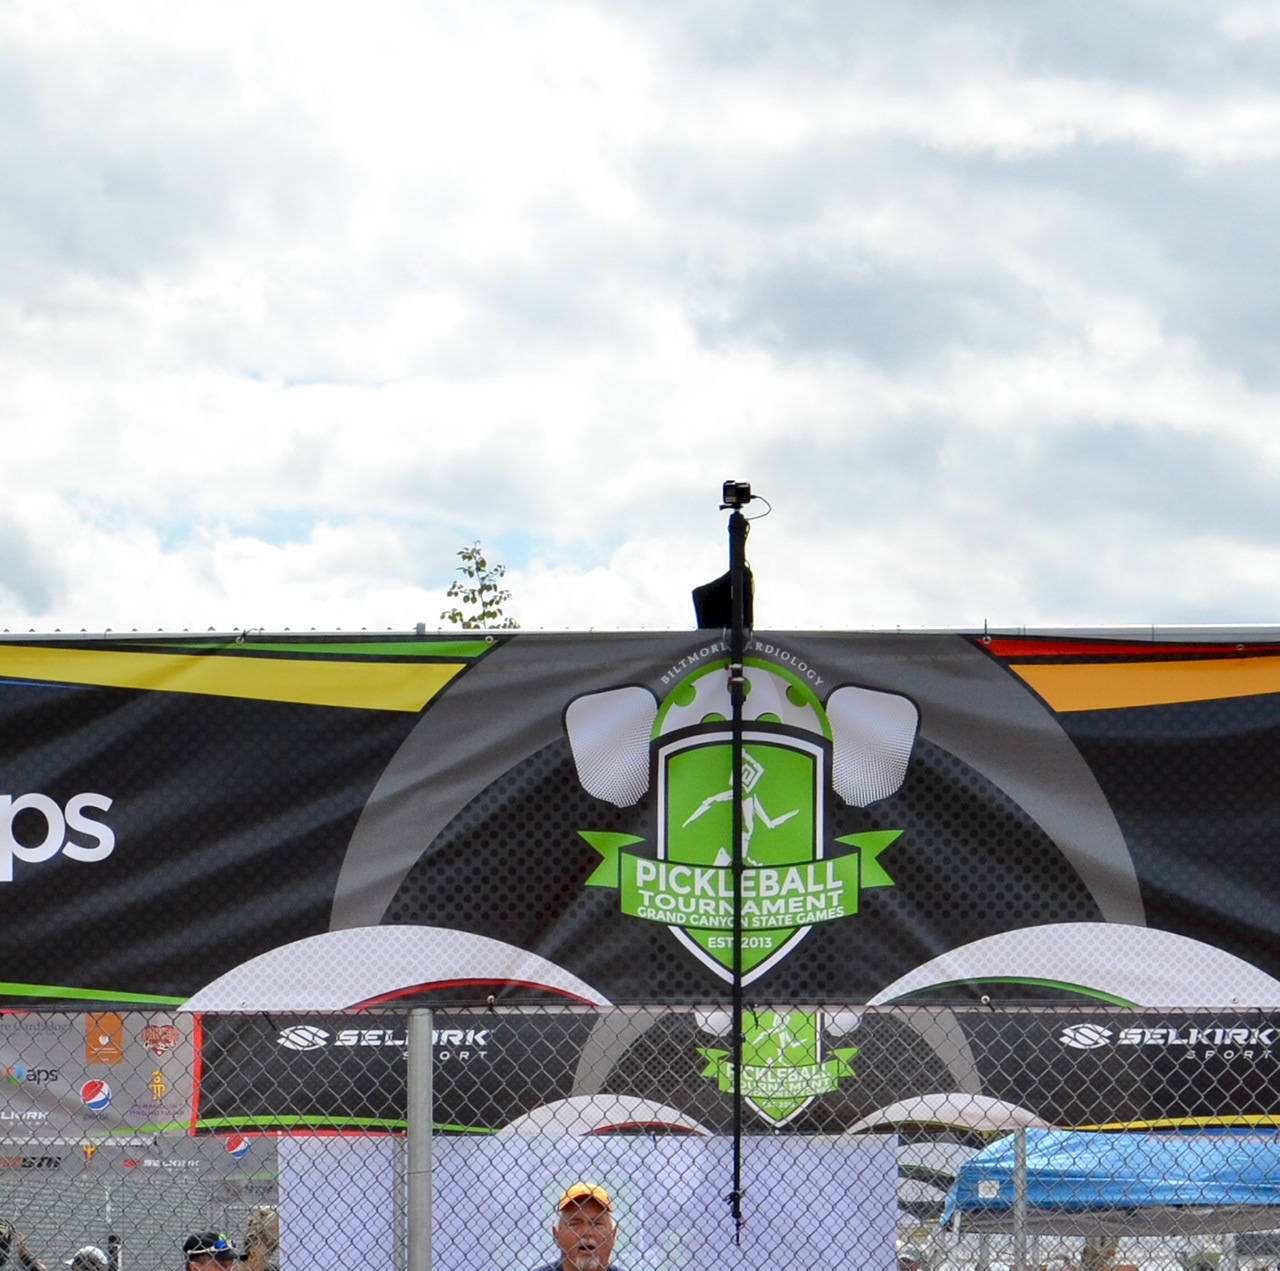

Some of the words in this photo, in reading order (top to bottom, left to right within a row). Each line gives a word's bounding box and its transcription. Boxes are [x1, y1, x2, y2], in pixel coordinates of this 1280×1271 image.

[636, 859, 844, 898] PICKLEBALL
[638, 890, 844, 916] TOURNAMENT
[636, 906, 686, 924] GRAND
[752, 914, 793, 927] STATE
[796, 906, 845, 924] GAMES
[741, 936, 773, 949] 2013
[333, 1029, 489, 1046] SELIRK
[1118, 1028, 1275, 1045] SELKIRK
[402, 1051, 488, 1060] SORT
[1186, 1050, 1272, 1059] SPORT
[25, 1066, 59, 1085] aps
[727, 1062, 831, 1082] PCKLEBALL
